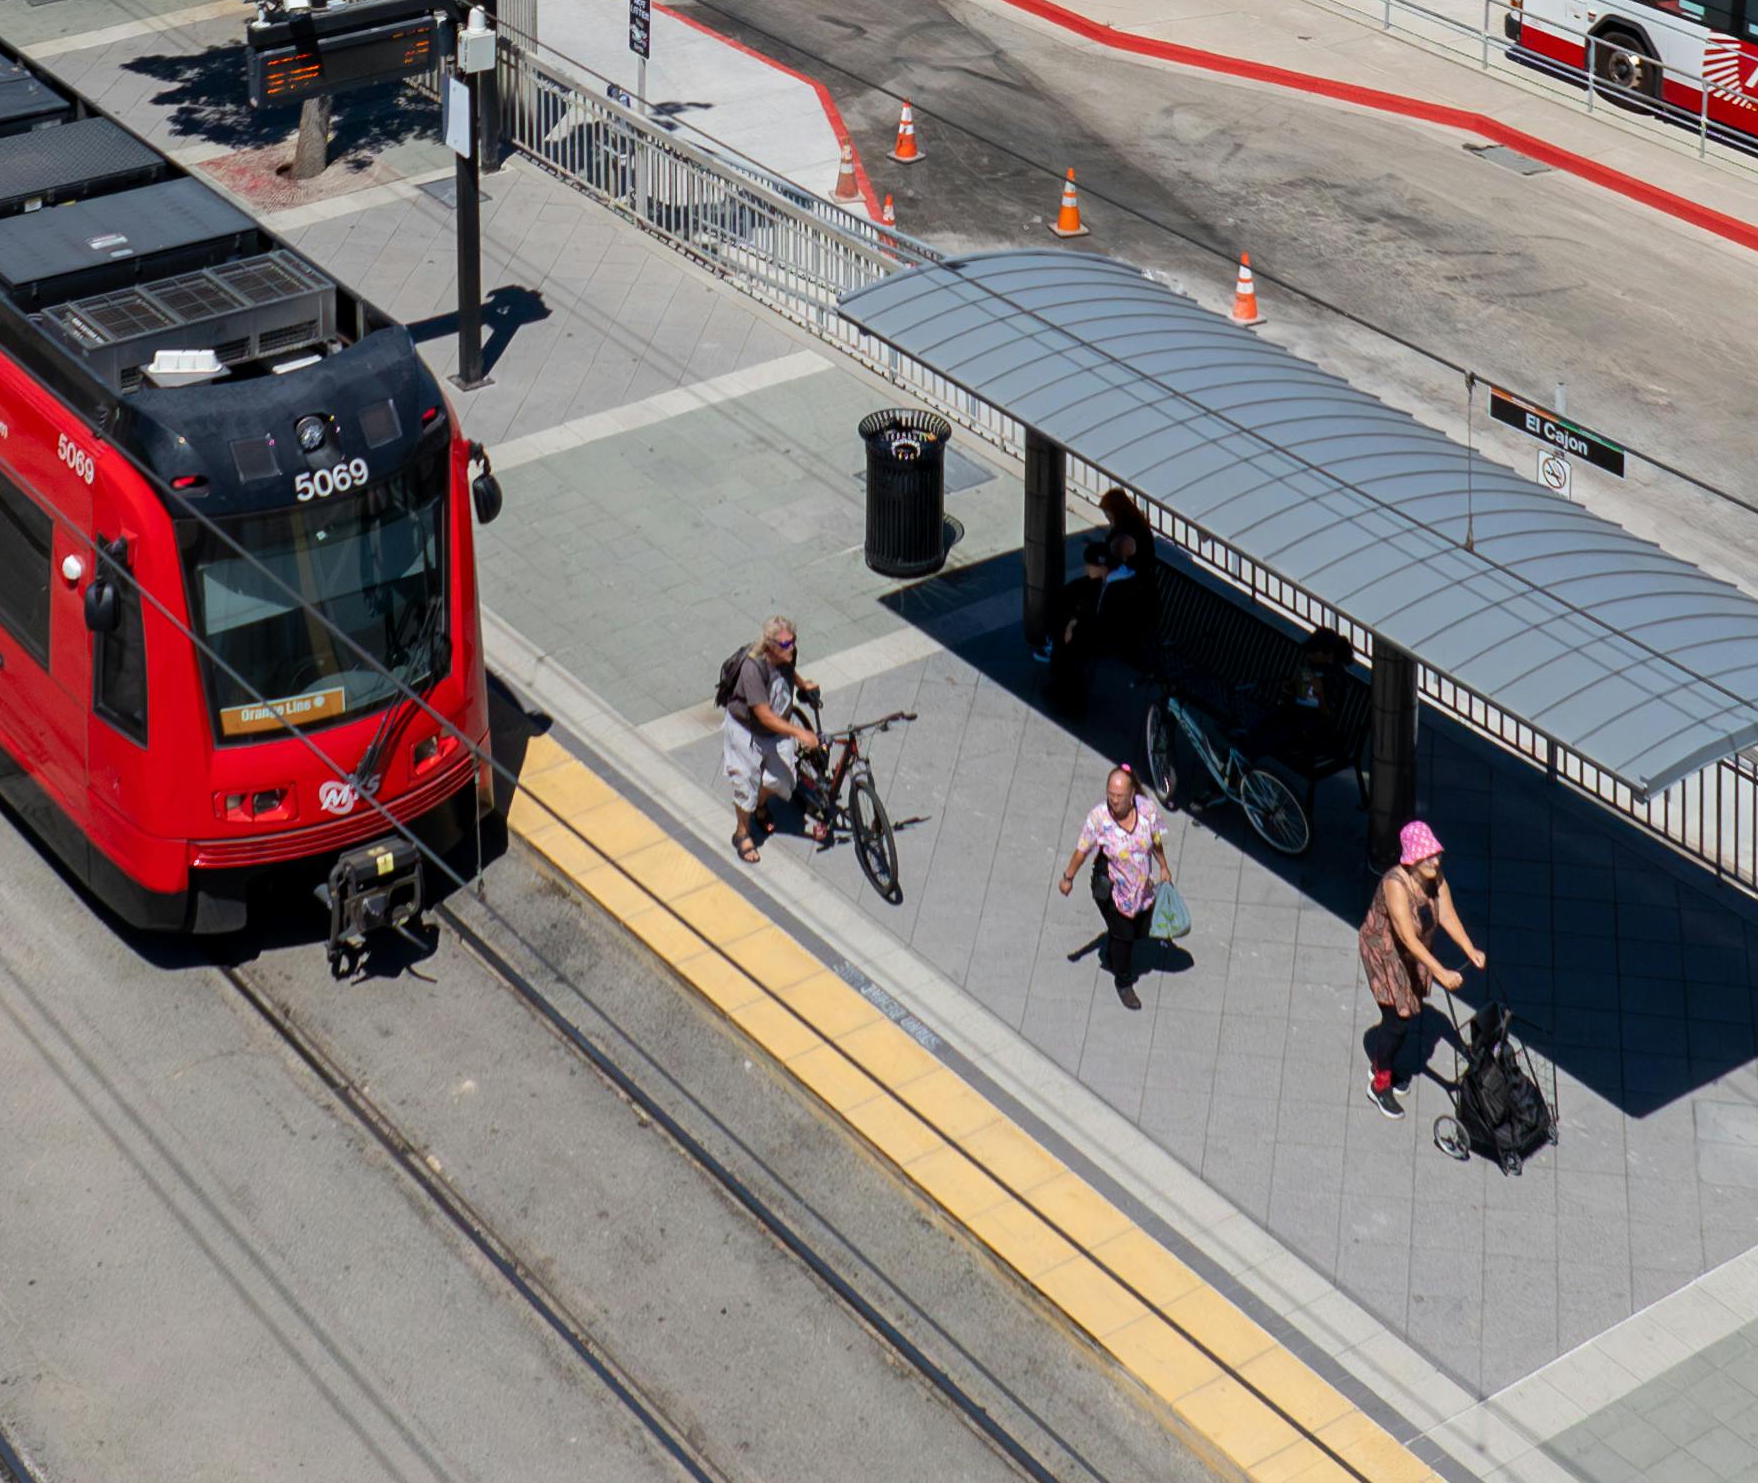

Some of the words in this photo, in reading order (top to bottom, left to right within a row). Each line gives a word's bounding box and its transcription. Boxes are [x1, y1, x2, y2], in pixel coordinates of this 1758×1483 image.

[1525, 413, 1541, 434] El
[1543, 421, 1588, 456] Cajon
[57, 433, 94, 485] 5069
[295, 457, 369, 502] 5069
[241, 705, 285, 722] Orange
[286, 699, 312, 716] Line
